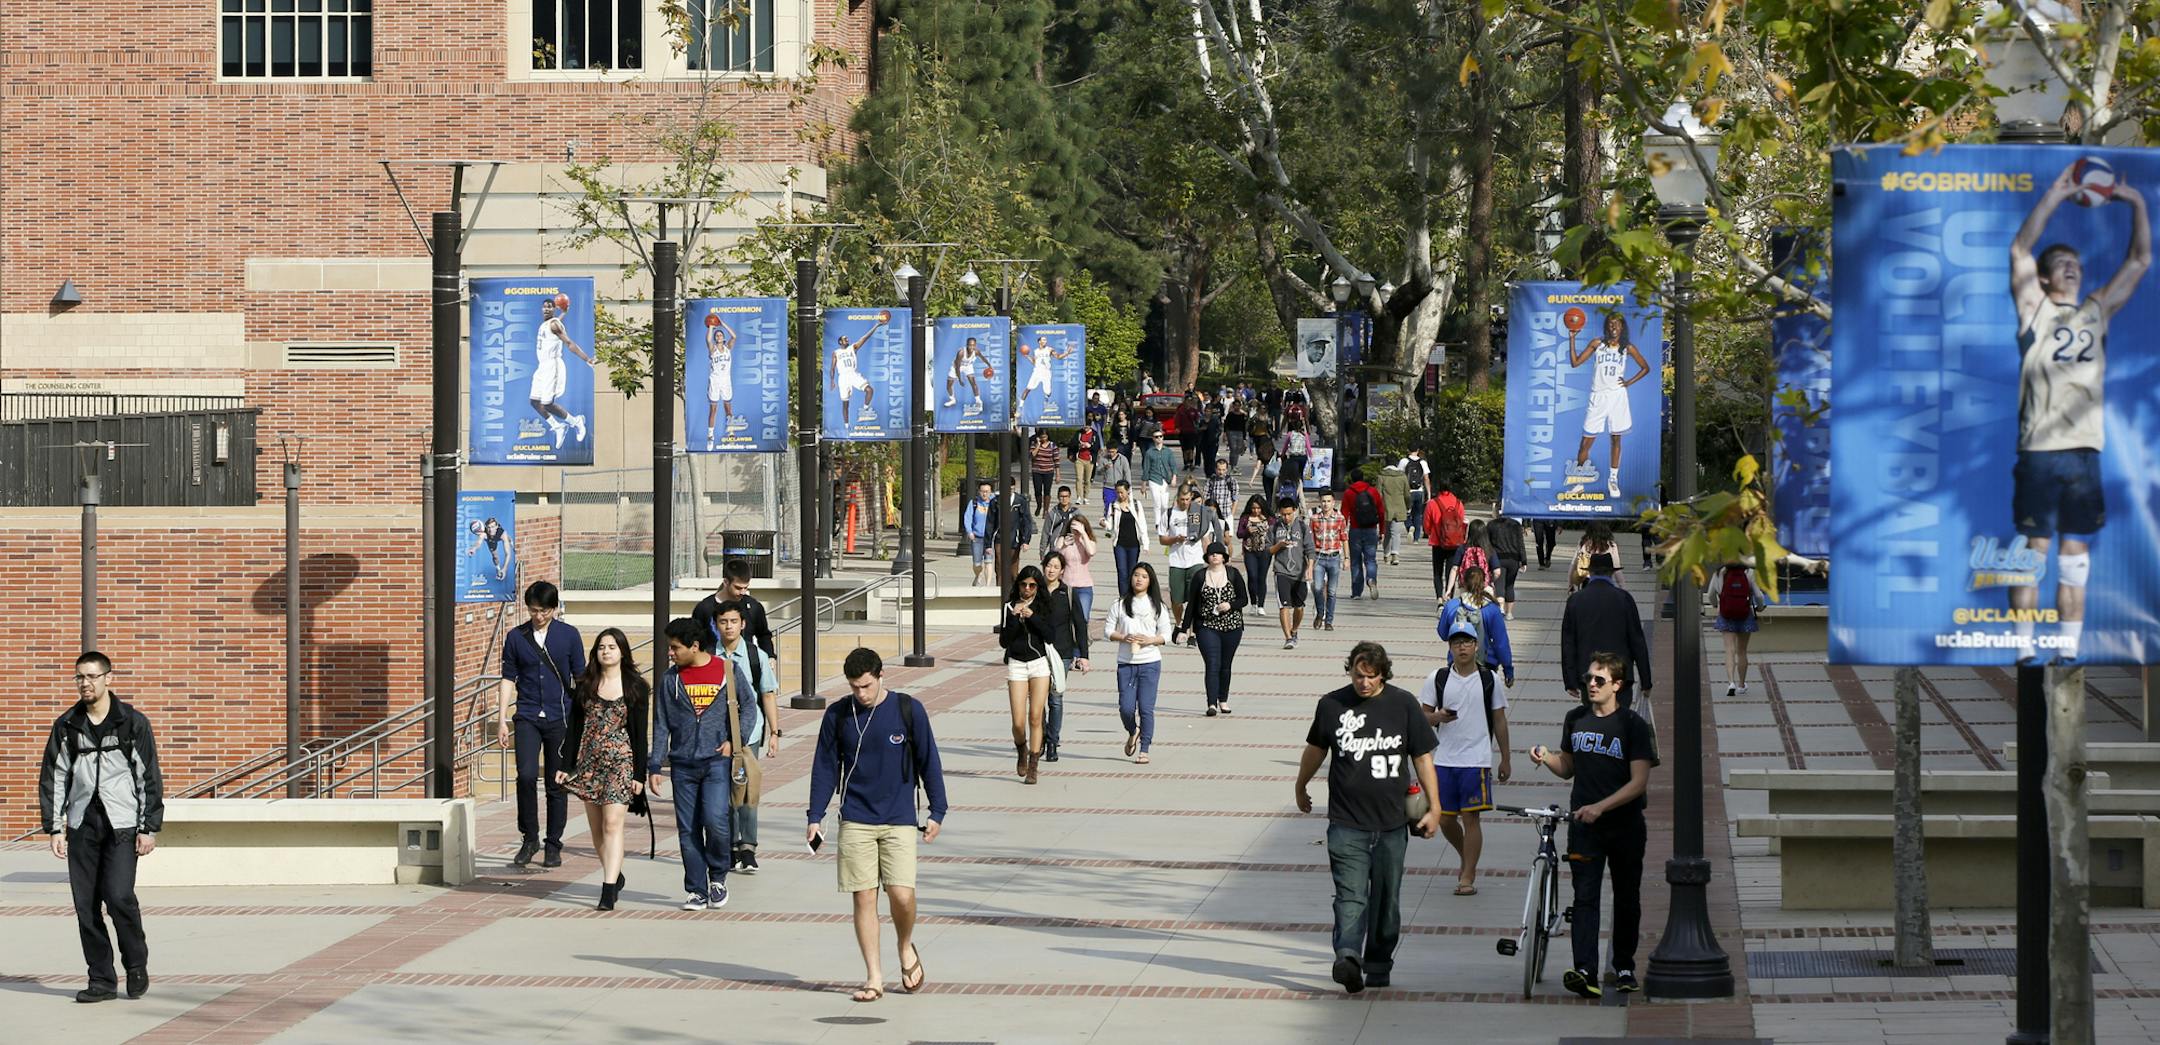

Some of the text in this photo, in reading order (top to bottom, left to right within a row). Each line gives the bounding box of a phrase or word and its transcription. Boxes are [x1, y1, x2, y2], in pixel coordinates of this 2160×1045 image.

[1881, 172, 2034, 192] #GOBRUINS
[504, 287, 559, 295] #GOBRUINS
[1941, 210, 2016, 434] UCLA
[504, 301, 533, 382] UCLA
[740, 317, 762, 385] UCLA
[2052, 327, 2094, 362] 22
[481, 300, 504, 447] BASKETBALL
[762, 317, 780, 440] BASKETBALL
[889, 327, 904, 429] BASKETBALL
[1523, 311, 1557, 497] BASKETBALL
[1877, 207, 1941, 608] VOLLEYBALL
[1557, 492, 1604, 501] @UCLAWBB
[1952, 607, 2059, 625] @UCLAMVB
[1335, 709, 1367, 737] Los
[1337, 728, 1403, 761] Psychos
[1571, 731, 1624, 759] UCLA
[1371, 754, 1402, 779] 97
